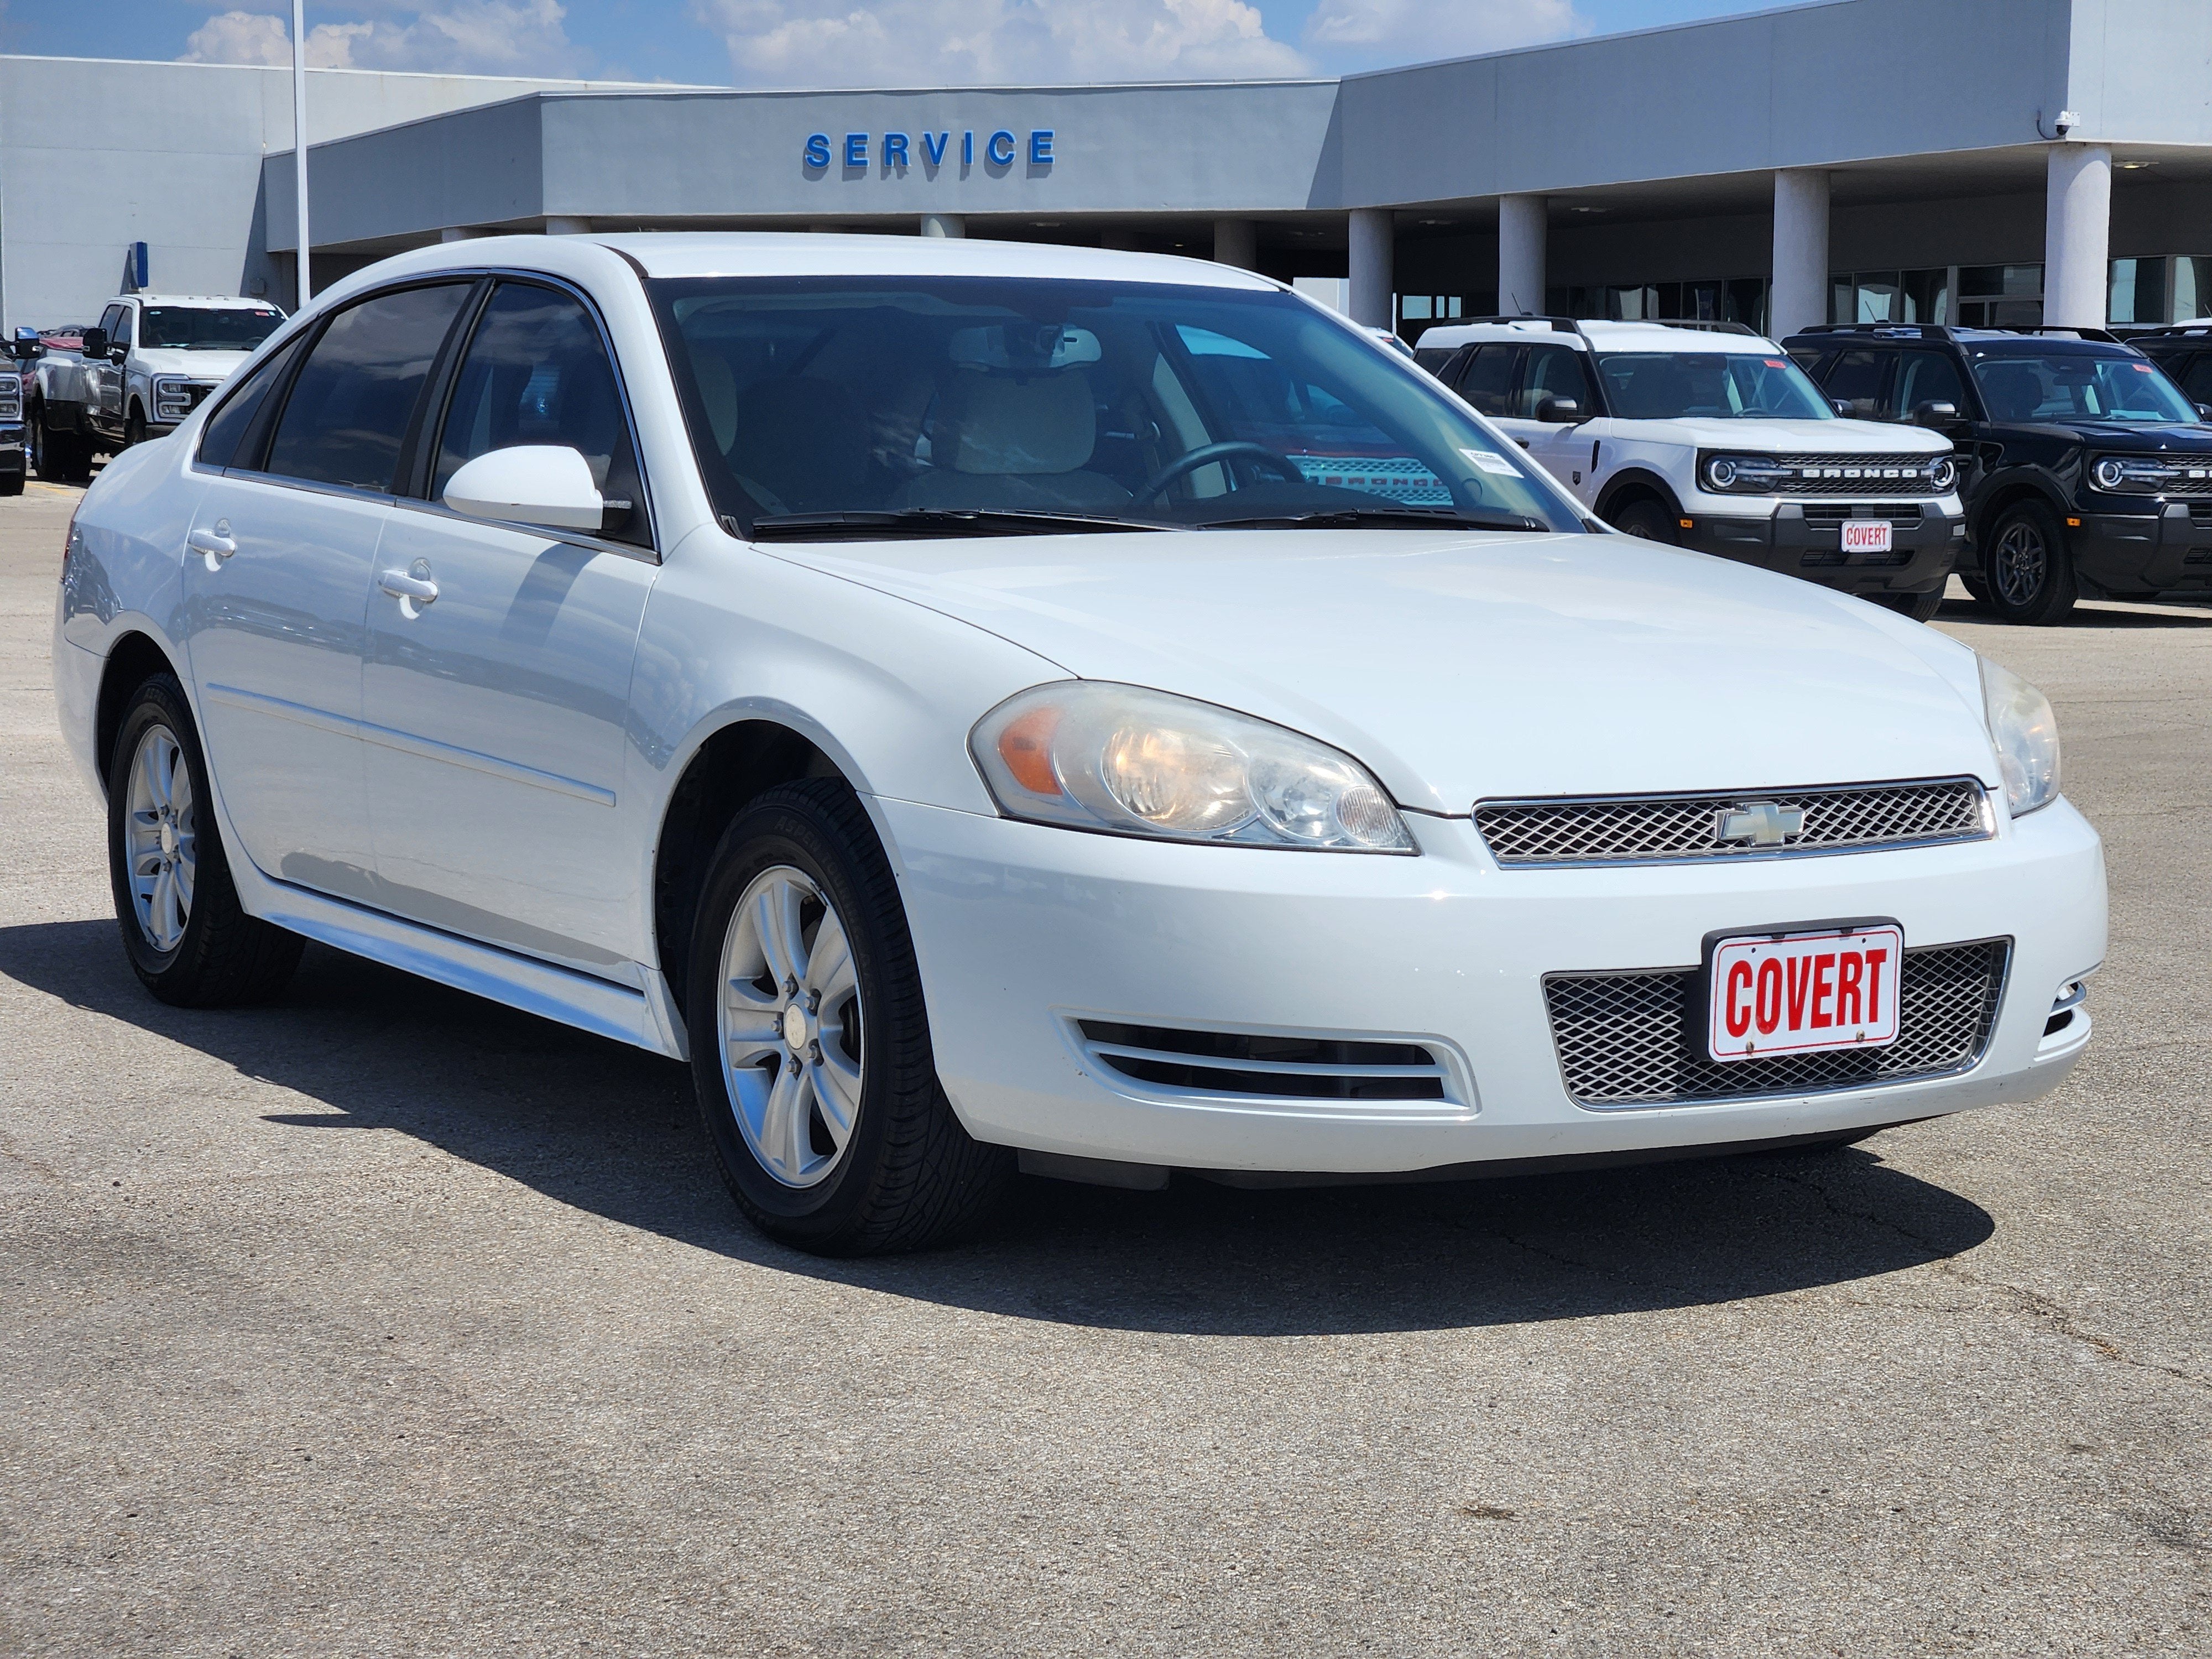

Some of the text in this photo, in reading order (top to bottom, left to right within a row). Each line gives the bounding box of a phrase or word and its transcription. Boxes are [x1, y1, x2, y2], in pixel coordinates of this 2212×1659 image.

[805, 129, 1055, 168] SERVICE
[1802, 469, 1917, 478] BRONCO
[1846, 527, 1887, 545] COVERT
[774, 816, 821, 852] ASPEN
[1726, 948, 1888, 1038] COVERT
